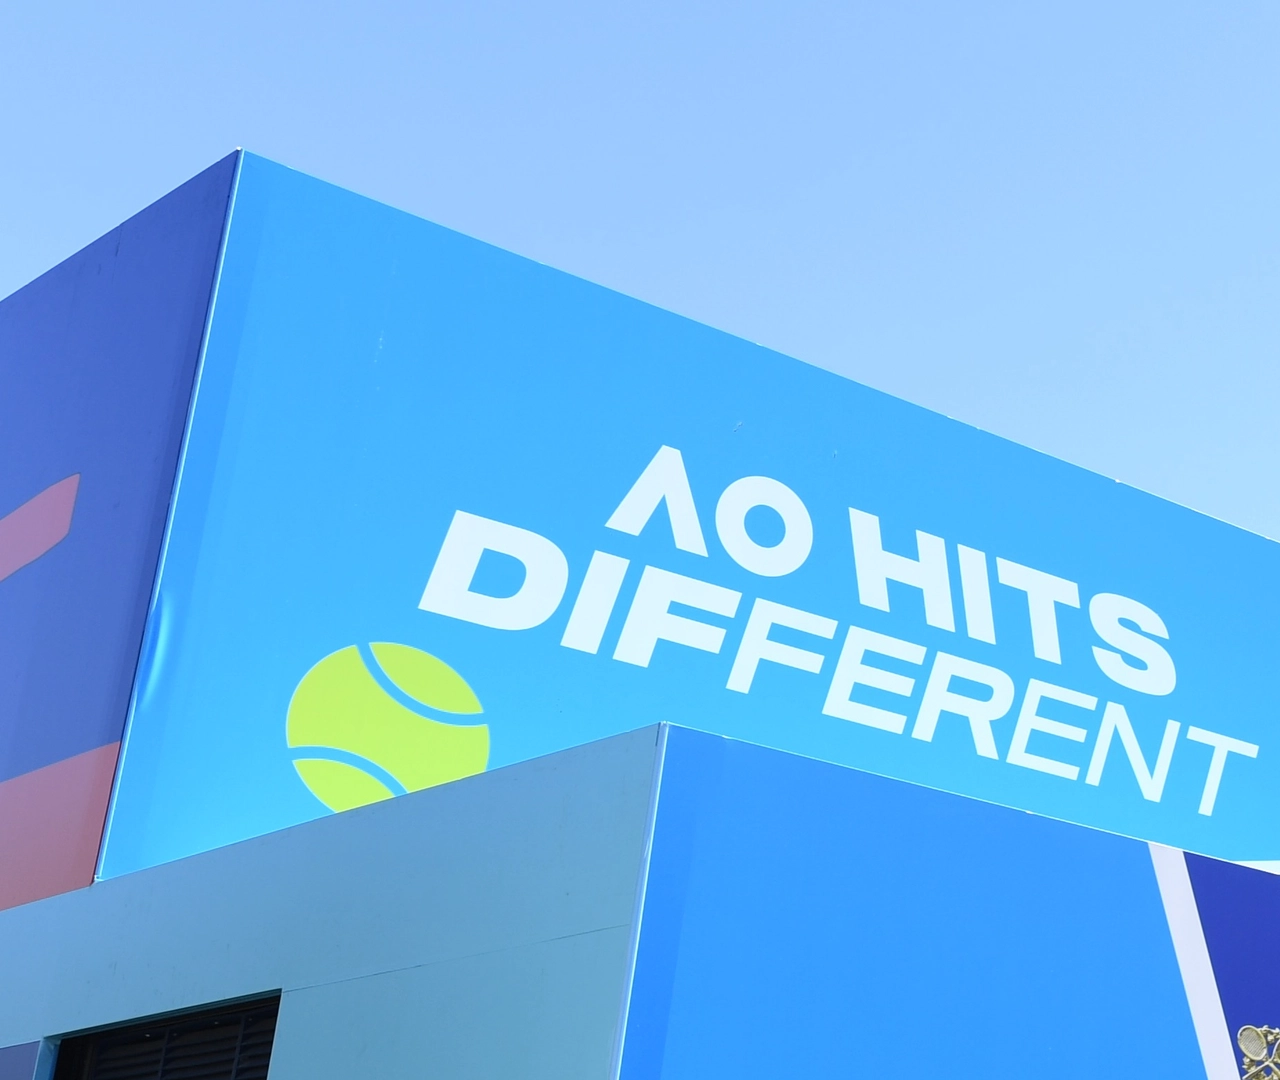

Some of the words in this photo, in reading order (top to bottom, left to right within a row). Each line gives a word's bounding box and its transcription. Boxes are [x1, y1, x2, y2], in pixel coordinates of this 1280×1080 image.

[417, 509, 1259, 816] DIFFERENT
[605, 444, 814, 577] AO
[849, 507, 1177, 696] HITS
